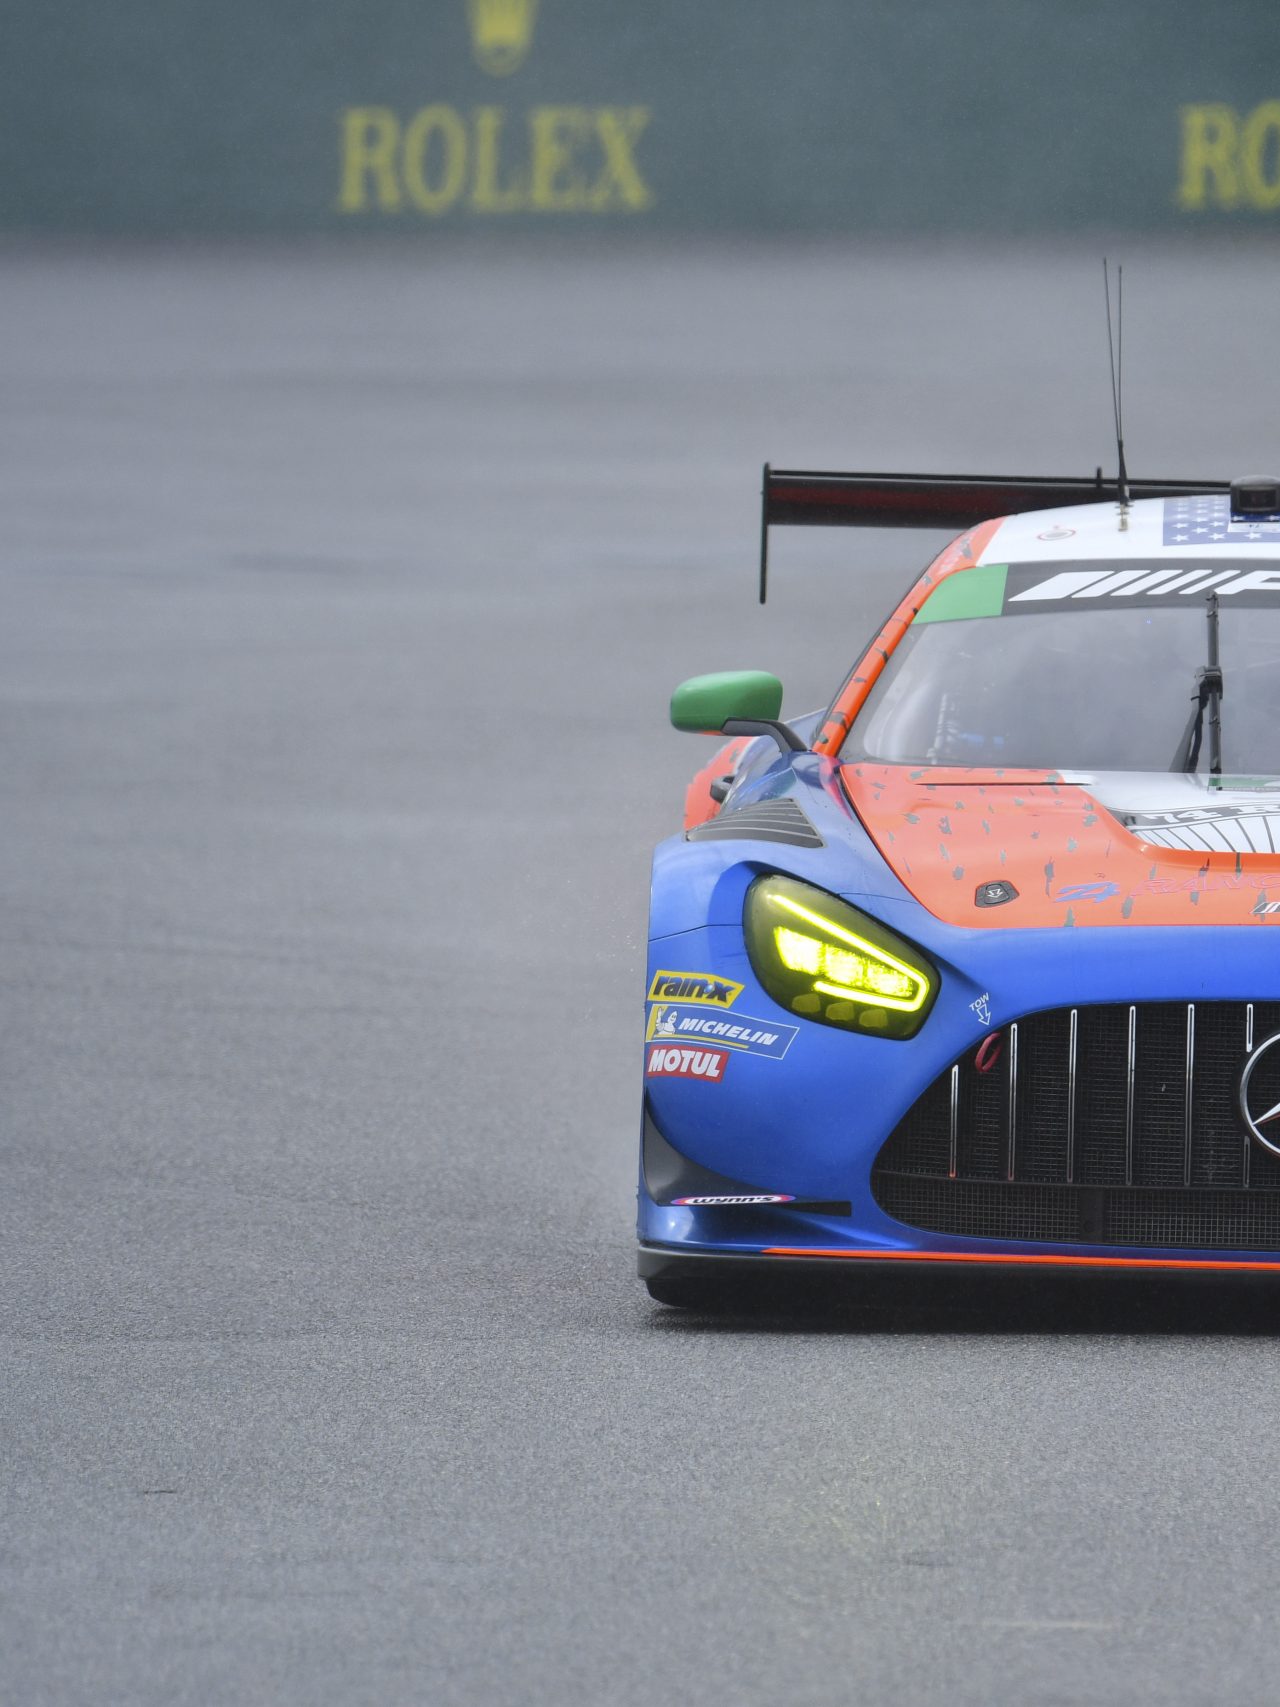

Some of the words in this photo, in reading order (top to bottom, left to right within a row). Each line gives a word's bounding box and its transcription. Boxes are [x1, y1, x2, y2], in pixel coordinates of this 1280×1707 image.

[338, 104, 653, 215] ROLEX
[968, 992, 990, 1011] TOW
[678, 1017, 779, 1046] MICHELIN
[647, 1049, 722, 1077] MOTUL
